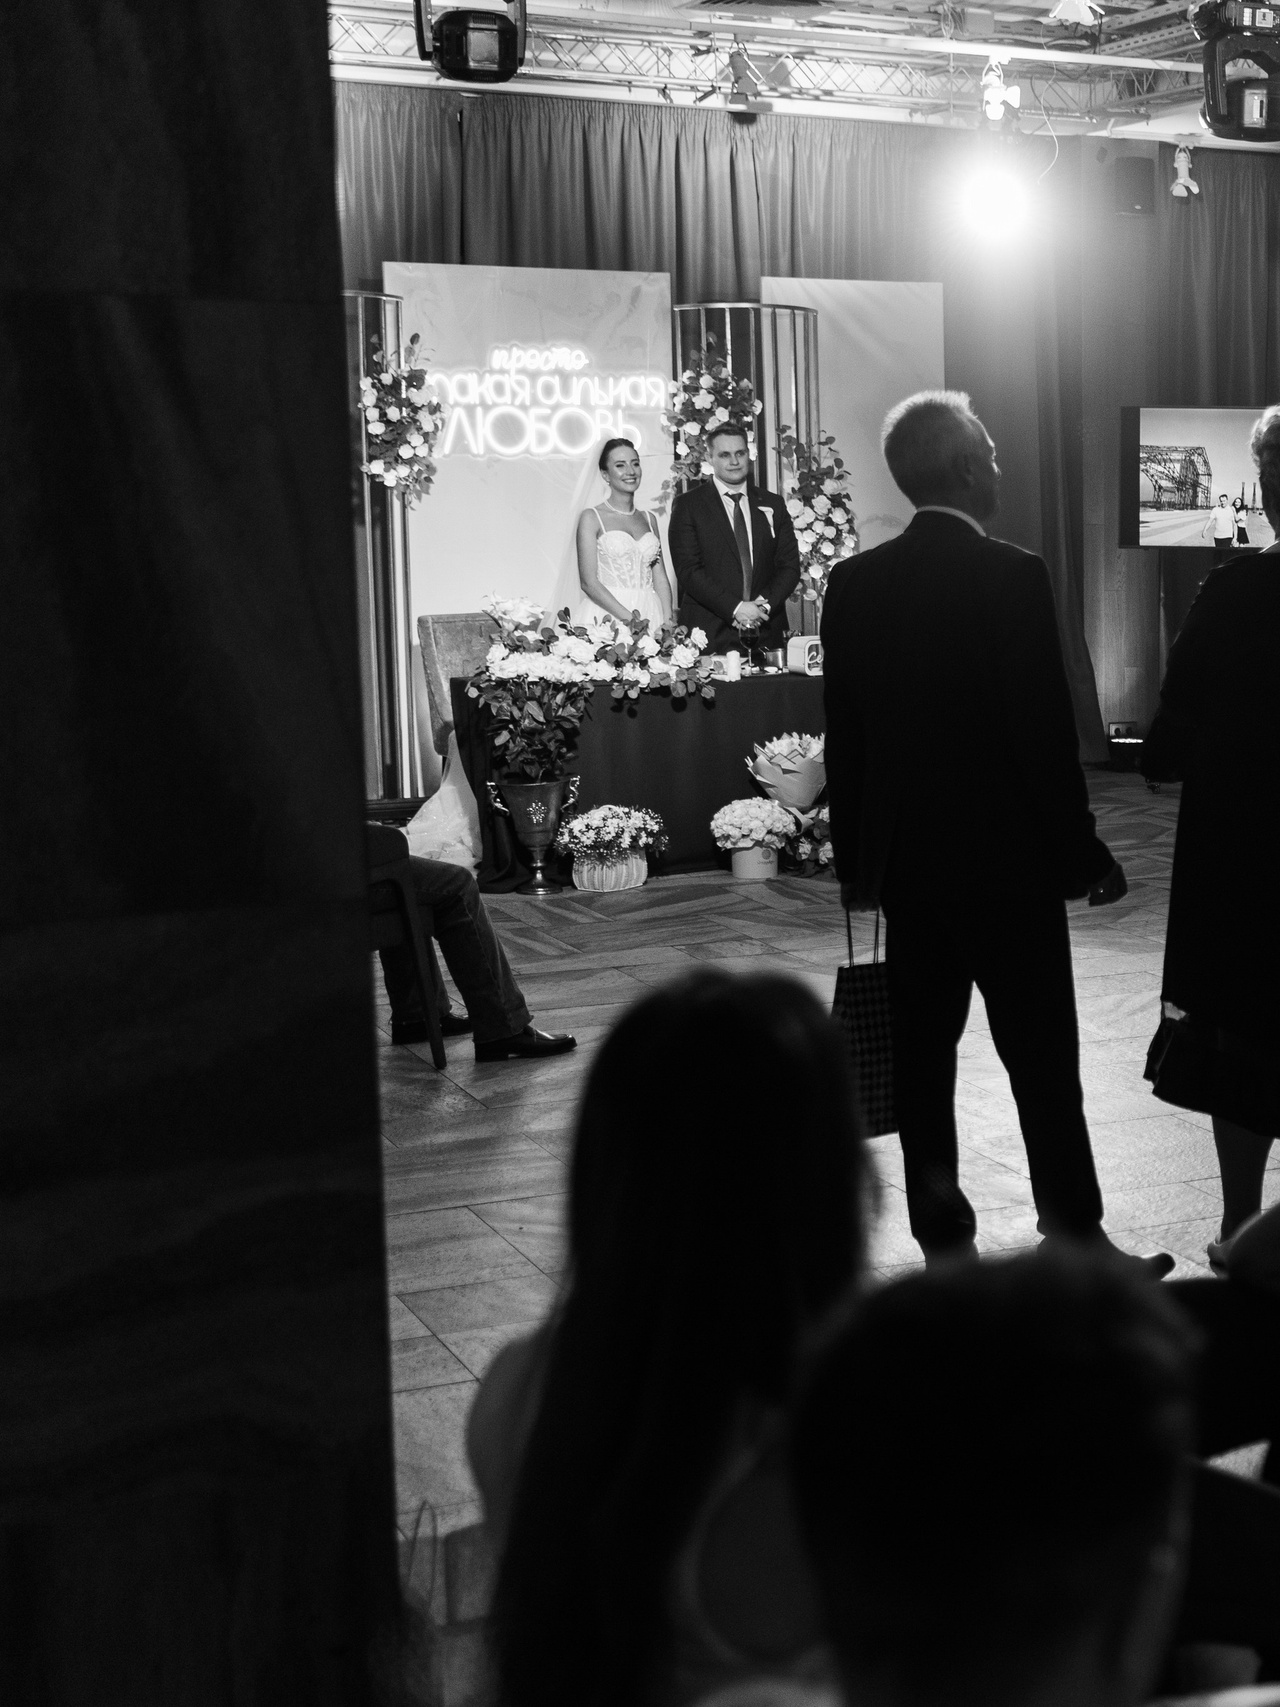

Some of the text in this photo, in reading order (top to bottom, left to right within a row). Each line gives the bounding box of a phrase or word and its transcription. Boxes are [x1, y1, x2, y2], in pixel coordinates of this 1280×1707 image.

[491, 347, 589, 377] просто
[537, 375, 665, 407] сильная
[444, 405, 642, 455] ЛЮБОВЬ
